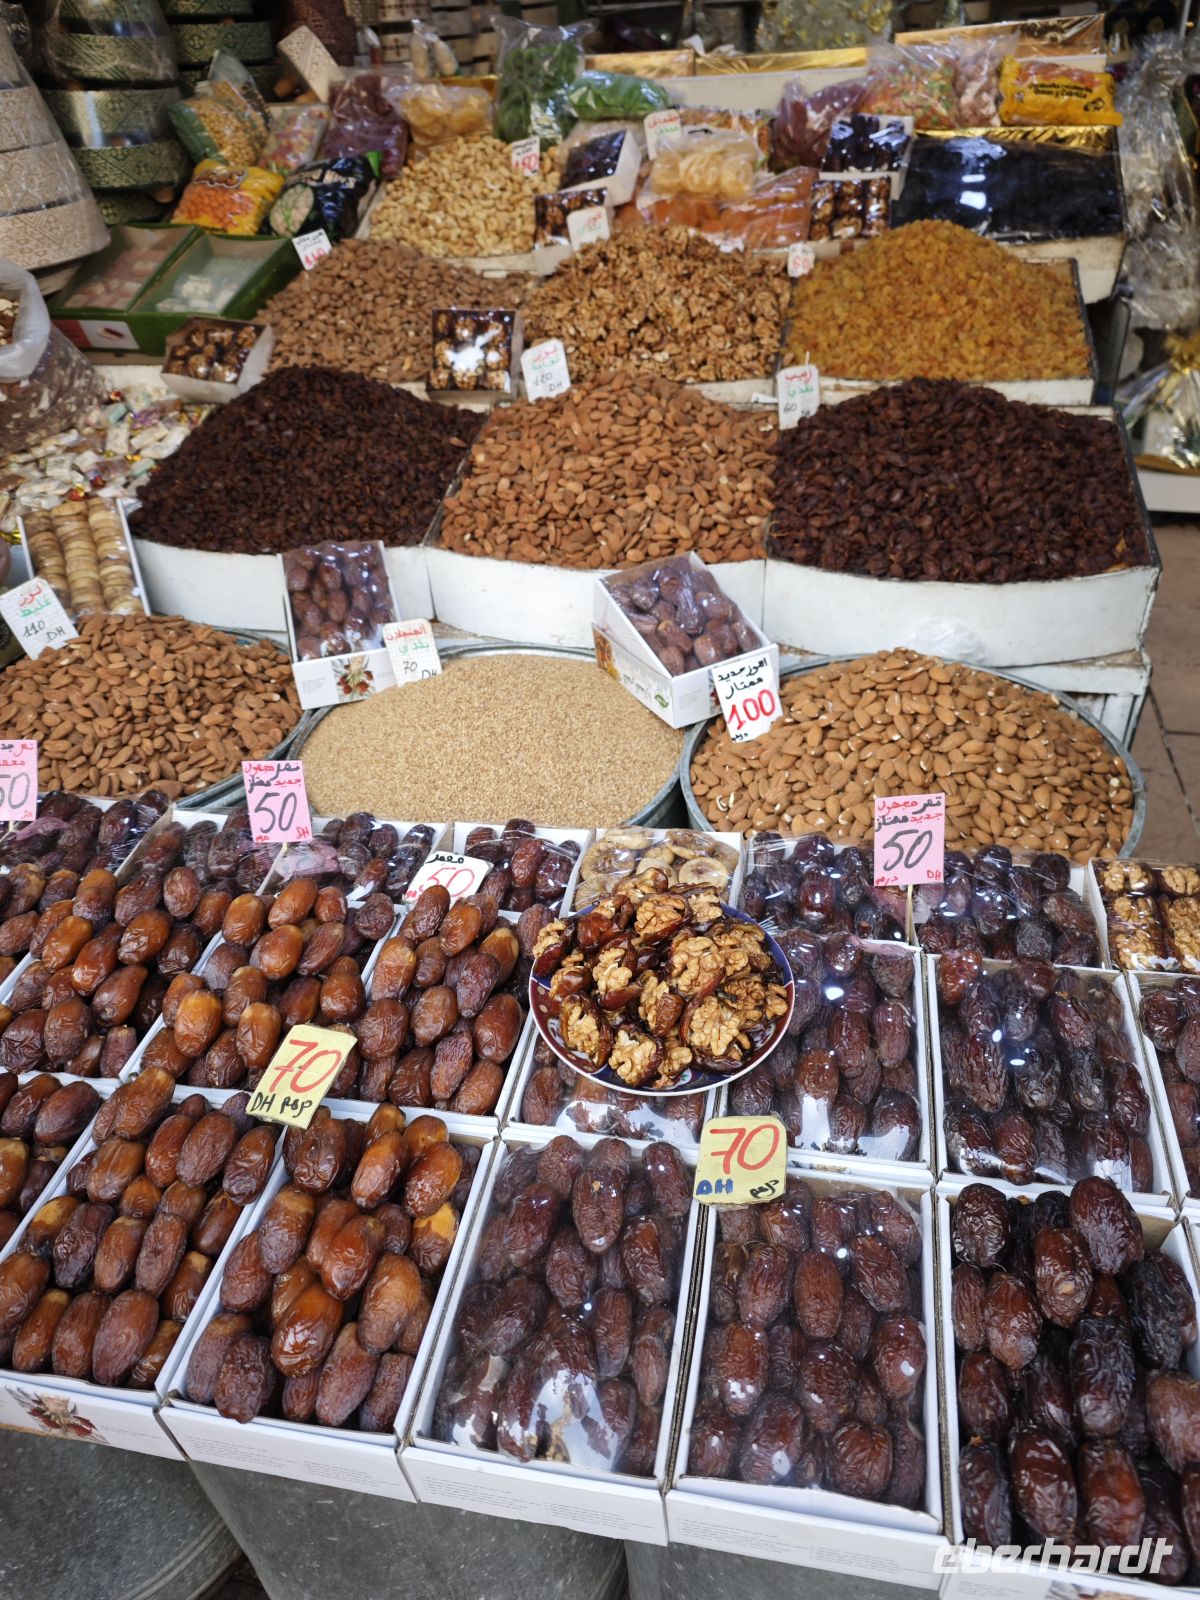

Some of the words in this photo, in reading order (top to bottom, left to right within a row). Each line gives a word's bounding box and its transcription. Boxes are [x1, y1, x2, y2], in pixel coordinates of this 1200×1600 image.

[23, 620, 46, 638] 110
[46, 626, 66, 642] DH
[402, 661, 418, 674] 70
[727, 689, 775, 731] 100
[254, 792, 297, 833] 50
[882, 829, 933, 871] 50
[427, 866, 475, 898] 50
[926, 869, 942, 881] DH
[268, 1038, 342, 1094] 70
[249, 1091, 277, 1113] DH
[709, 1123, 780, 1175] 70
[695, 1178, 734, 1196] DH
